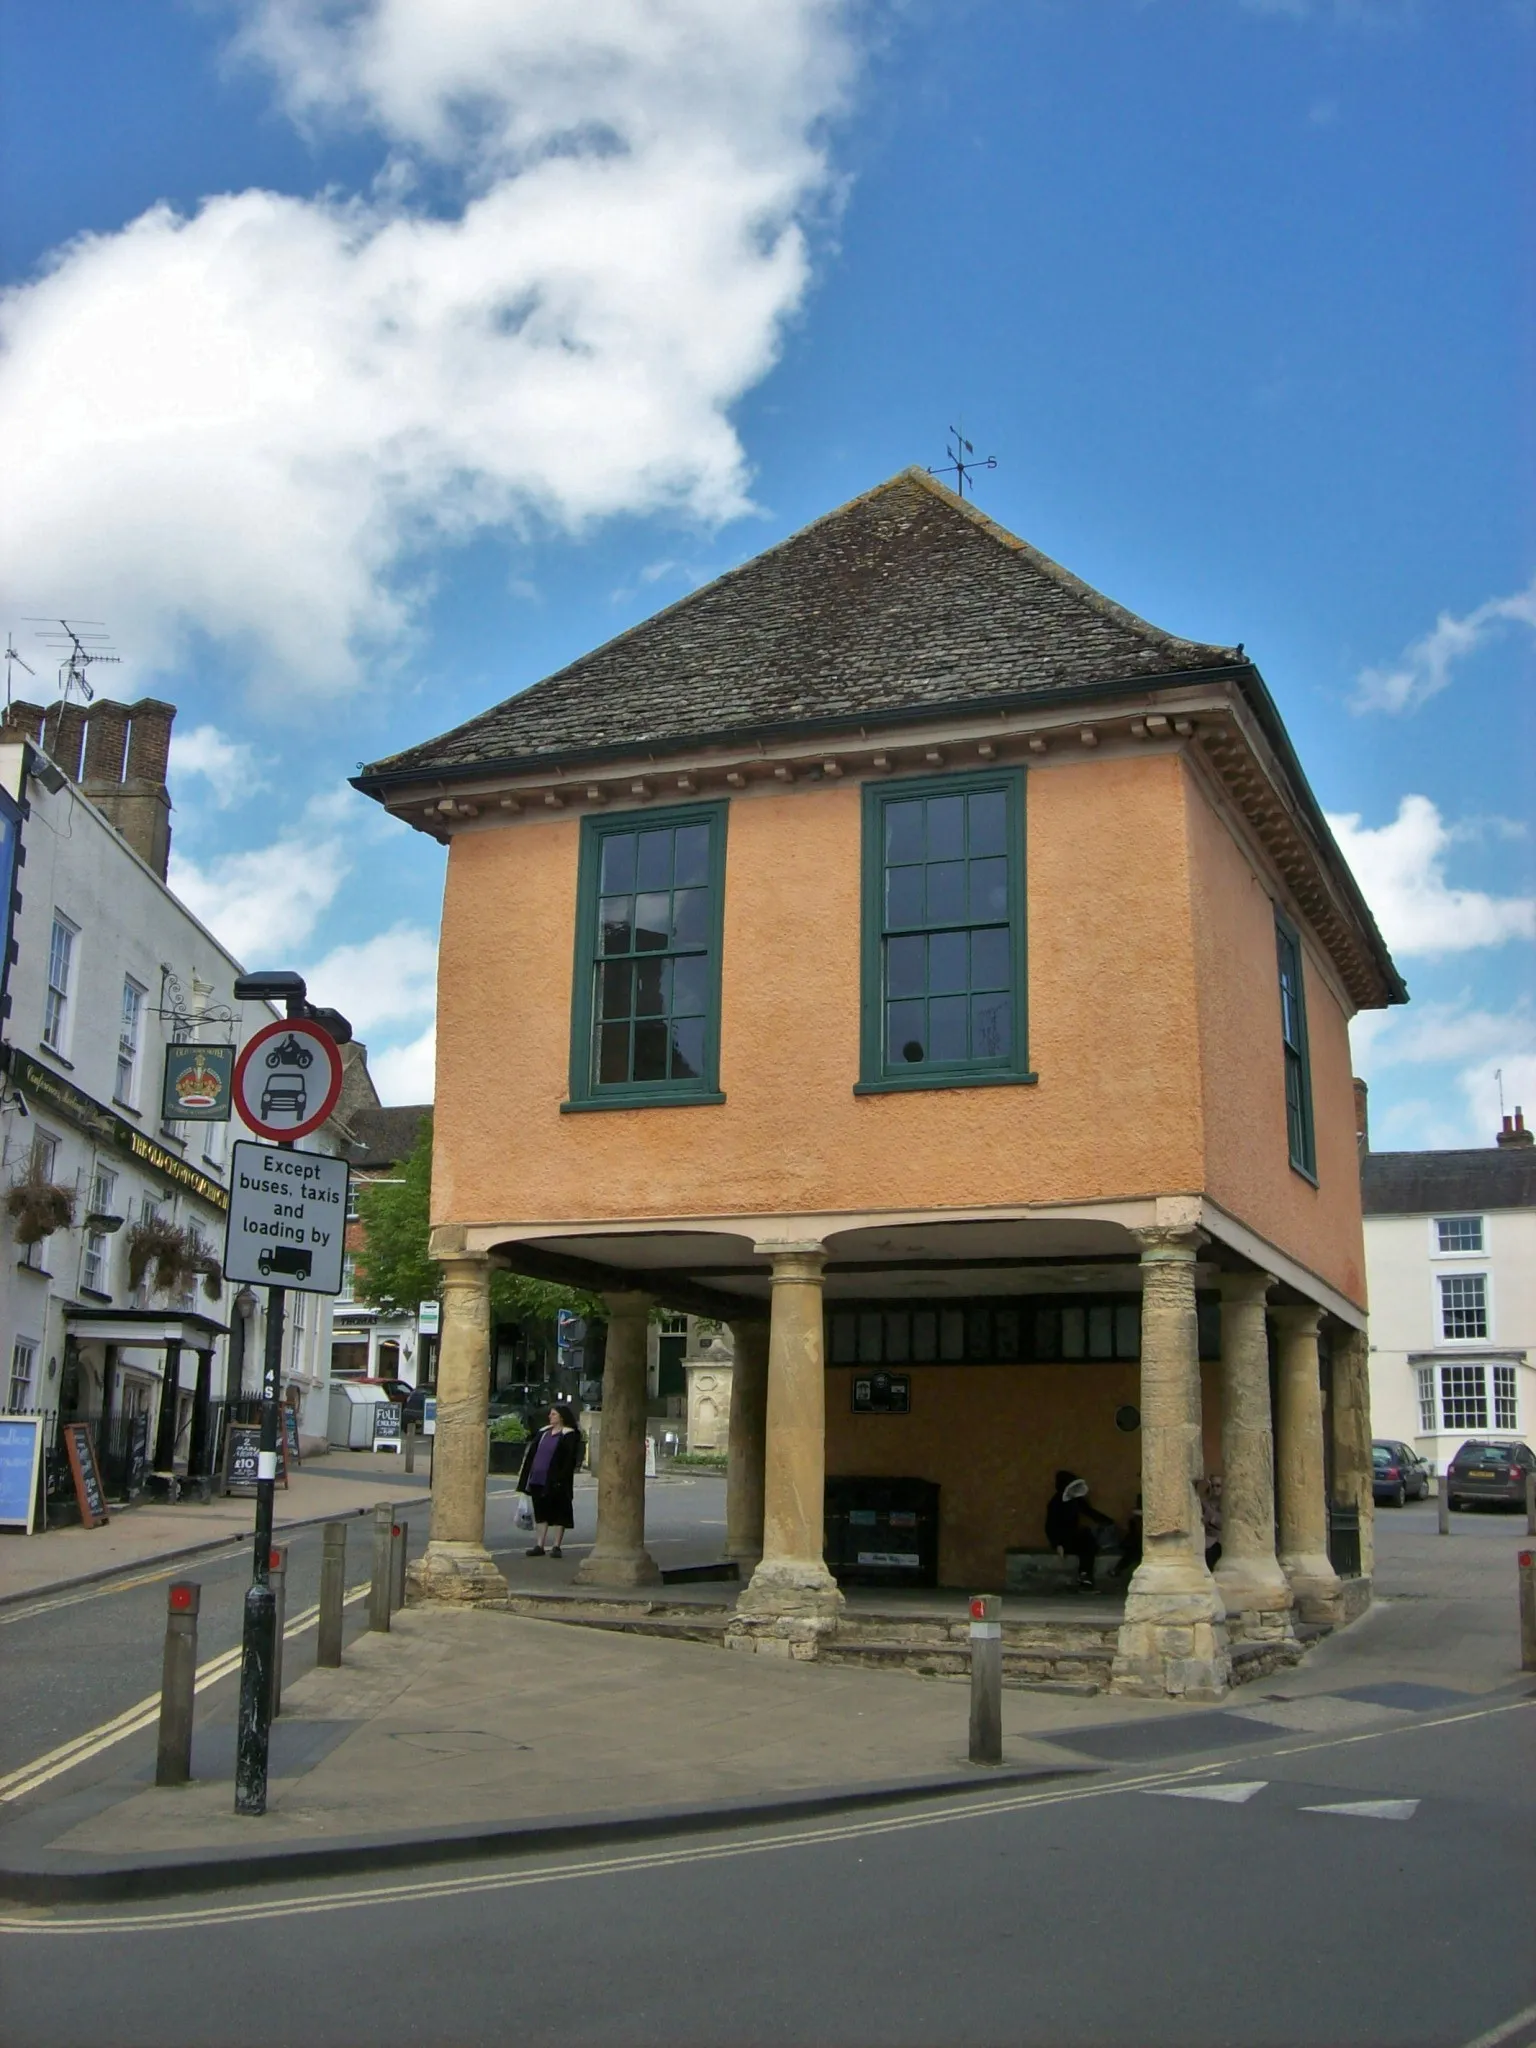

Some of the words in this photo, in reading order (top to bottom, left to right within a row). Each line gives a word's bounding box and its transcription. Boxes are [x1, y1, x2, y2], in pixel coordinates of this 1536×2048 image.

[264, 1155, 321, 1180] Except
[240, 1172, 293, 1197] buses,
[301, 1183, 340, 1204] taxis
[273, 1203, 304, 1219] and
[243, 1216, 305, 1243] loading
[311, 1227, 330, 1247] by
[340, 1317, 378, 1326] THOMAS
[265, 1369, 275, 1382] 4
[264, 1386, 274, 1399] S
[376, 1408, 399, 1420] FULL
[243, 1438, 251, 1446] 2
[233, 1458, 255, 1469] £10
